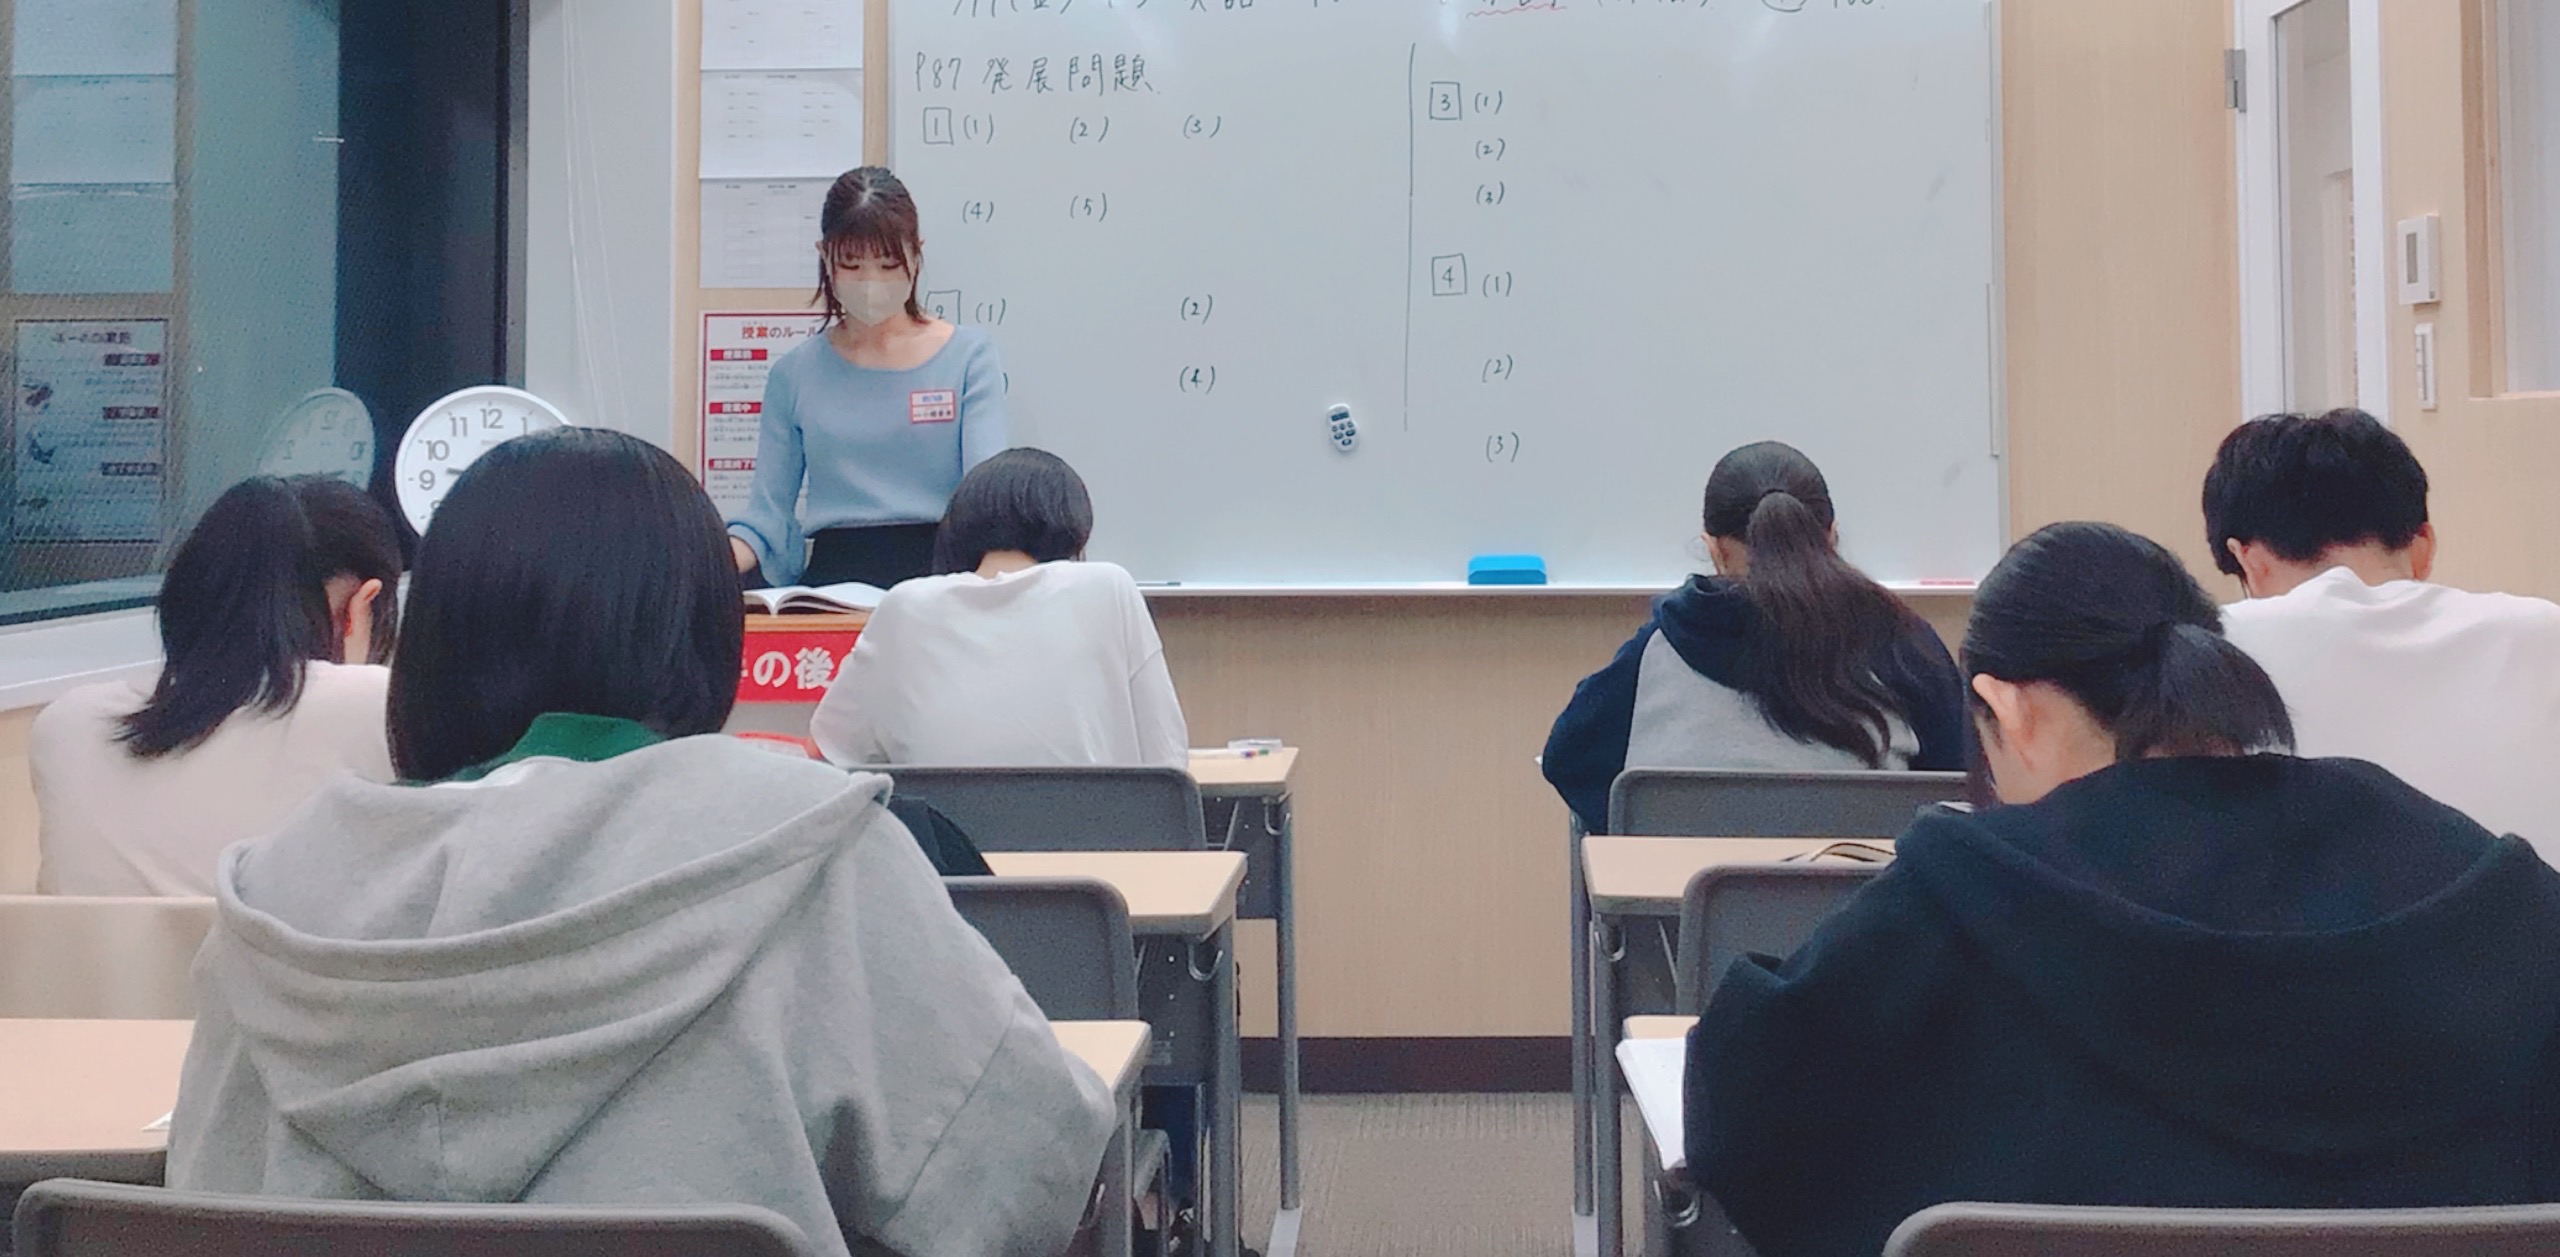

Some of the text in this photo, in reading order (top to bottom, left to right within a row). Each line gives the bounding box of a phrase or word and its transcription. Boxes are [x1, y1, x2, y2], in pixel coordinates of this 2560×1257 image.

[916, 51, 961, 92] P87
[1474, 90, 1504, 115] (1)
[963, 113, 994, 145] (1)
[1069, 116, 1110, 144] (2)
[1182, 115, 1222, 140] (3)
[1475, 137, 1506, 162] (2)
[1475, 181, 1505, 205] (3)
[962, 192, 1108, 223] (4) (5)
[1482, 271, 1513, 299] (1)
[975, 298, 1007, 326] (1)
[1180, 294, 1213, 324] (2)
[1179, 366, 1216, 394] (4)
[1481, 354, 1514, 383] (2)
[449, 416, 468, 438] 11
[479, 408, 504, 430] 12
[425, 439, 450, 461] 10
[1486, 431, 1520, 463] (3)
[418, 469, 436, 491] 9
[741, 647, 834, 690] の後
